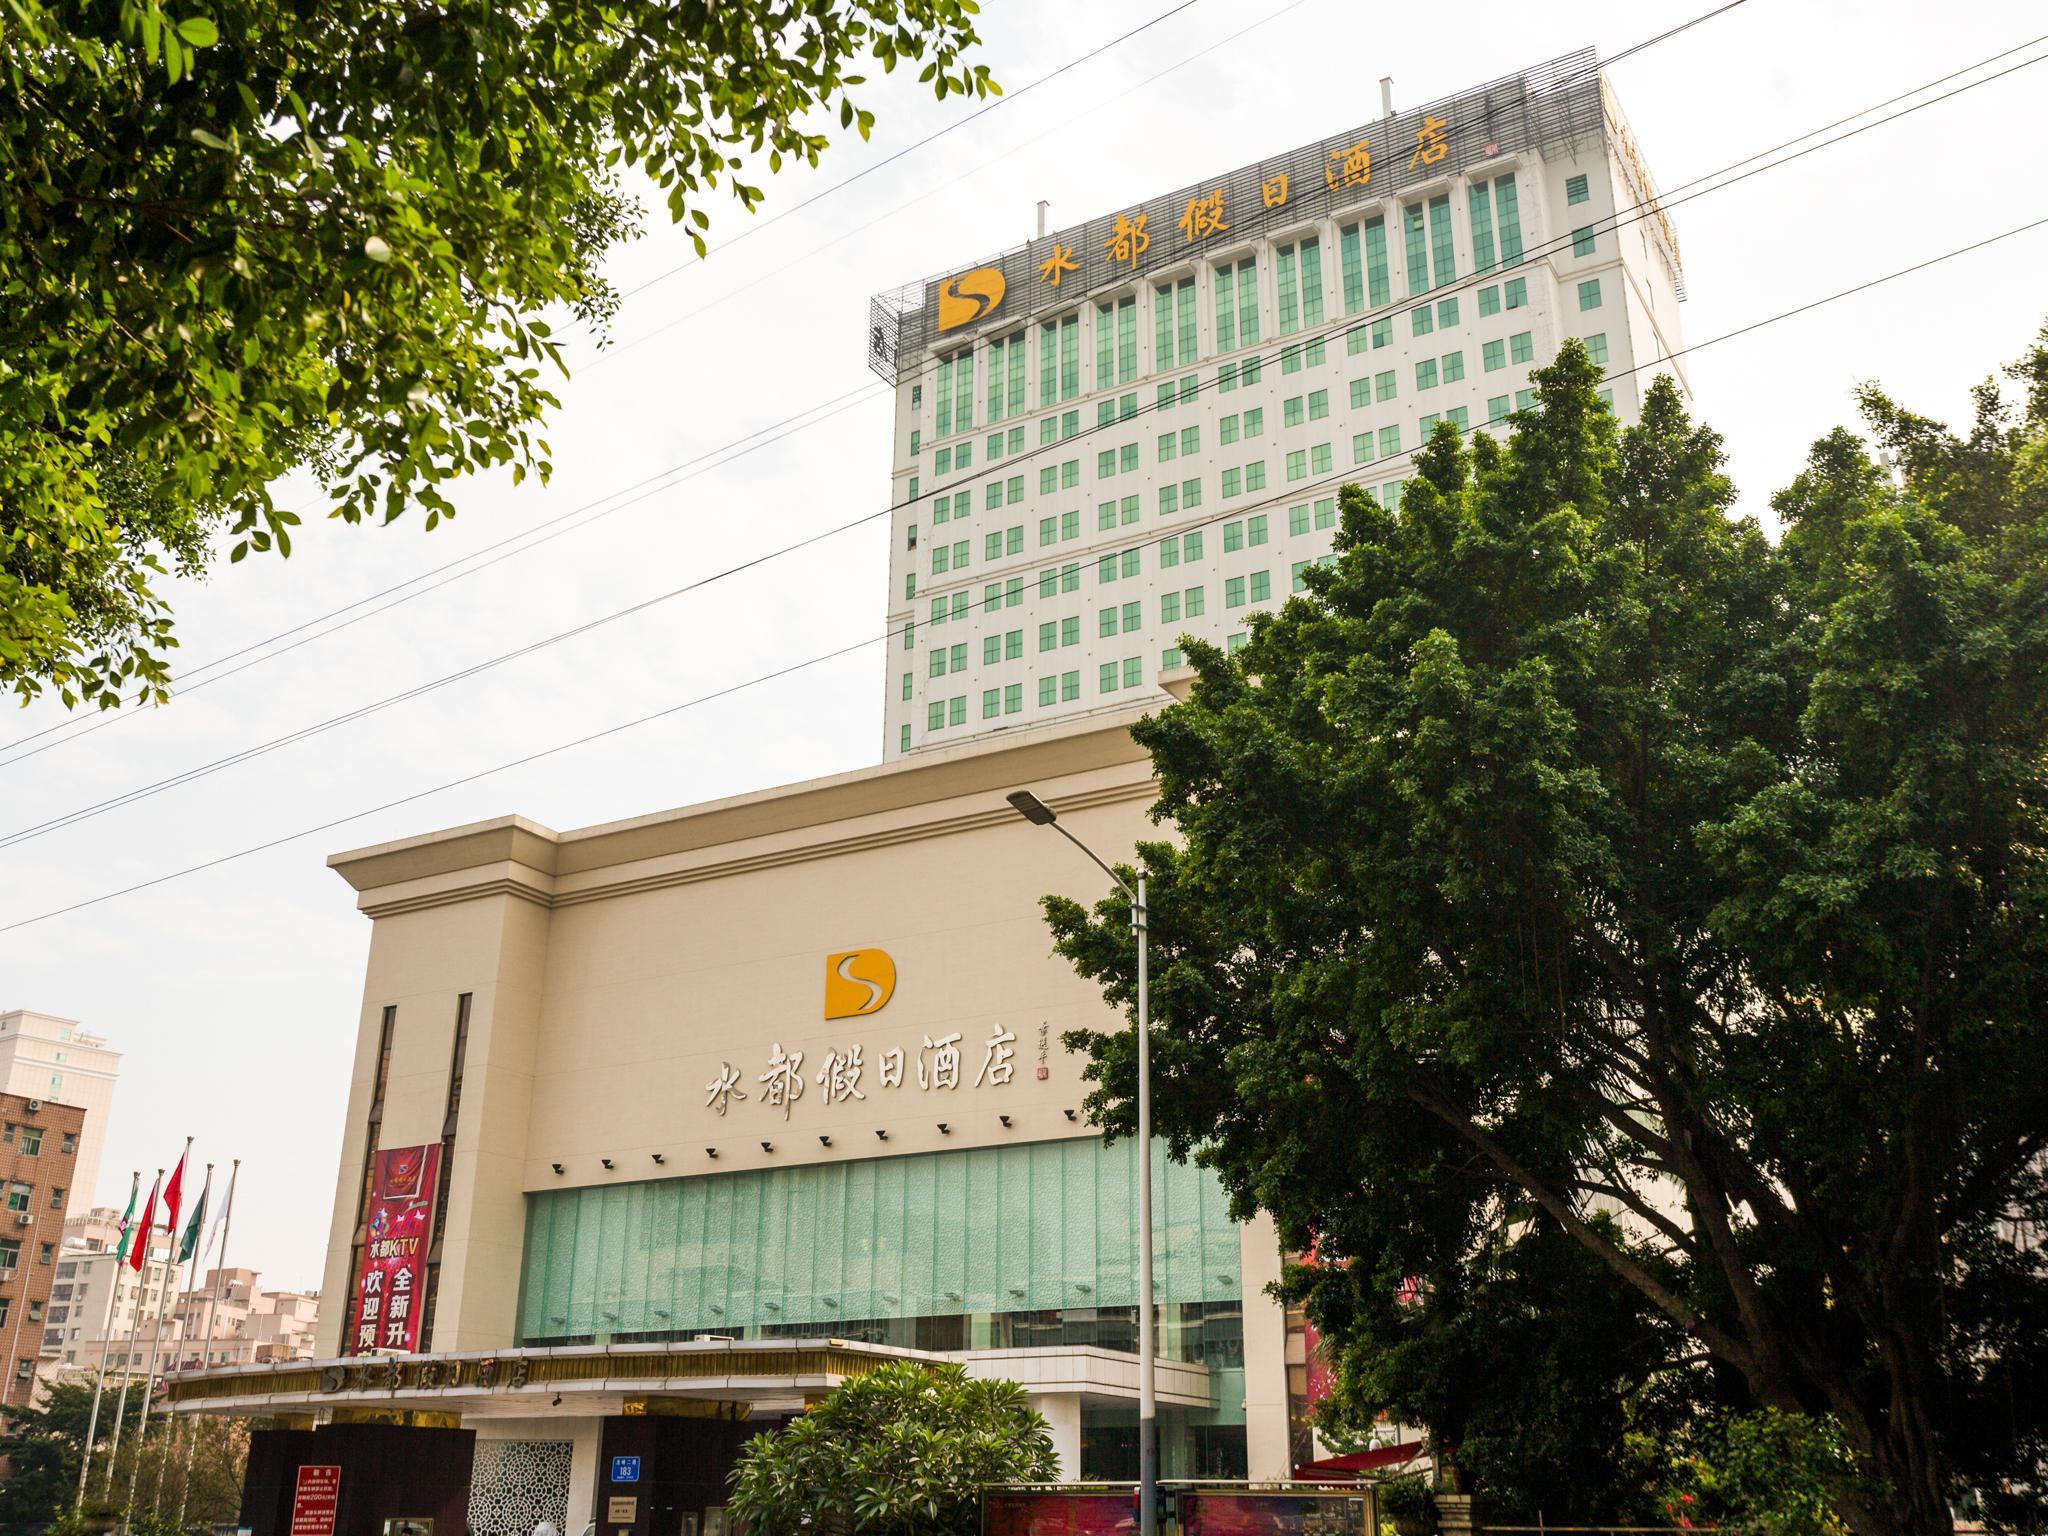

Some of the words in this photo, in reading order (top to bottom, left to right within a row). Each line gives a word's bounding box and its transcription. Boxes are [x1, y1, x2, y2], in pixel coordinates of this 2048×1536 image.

[1040, 117, 1449, 287] 水都假日酒店
[705, 1023, 1017, 1121] 水都假日酒店
[369, 1237, 420, 1258] 水都KTV
[620, 1466, 632, 1476] 183
